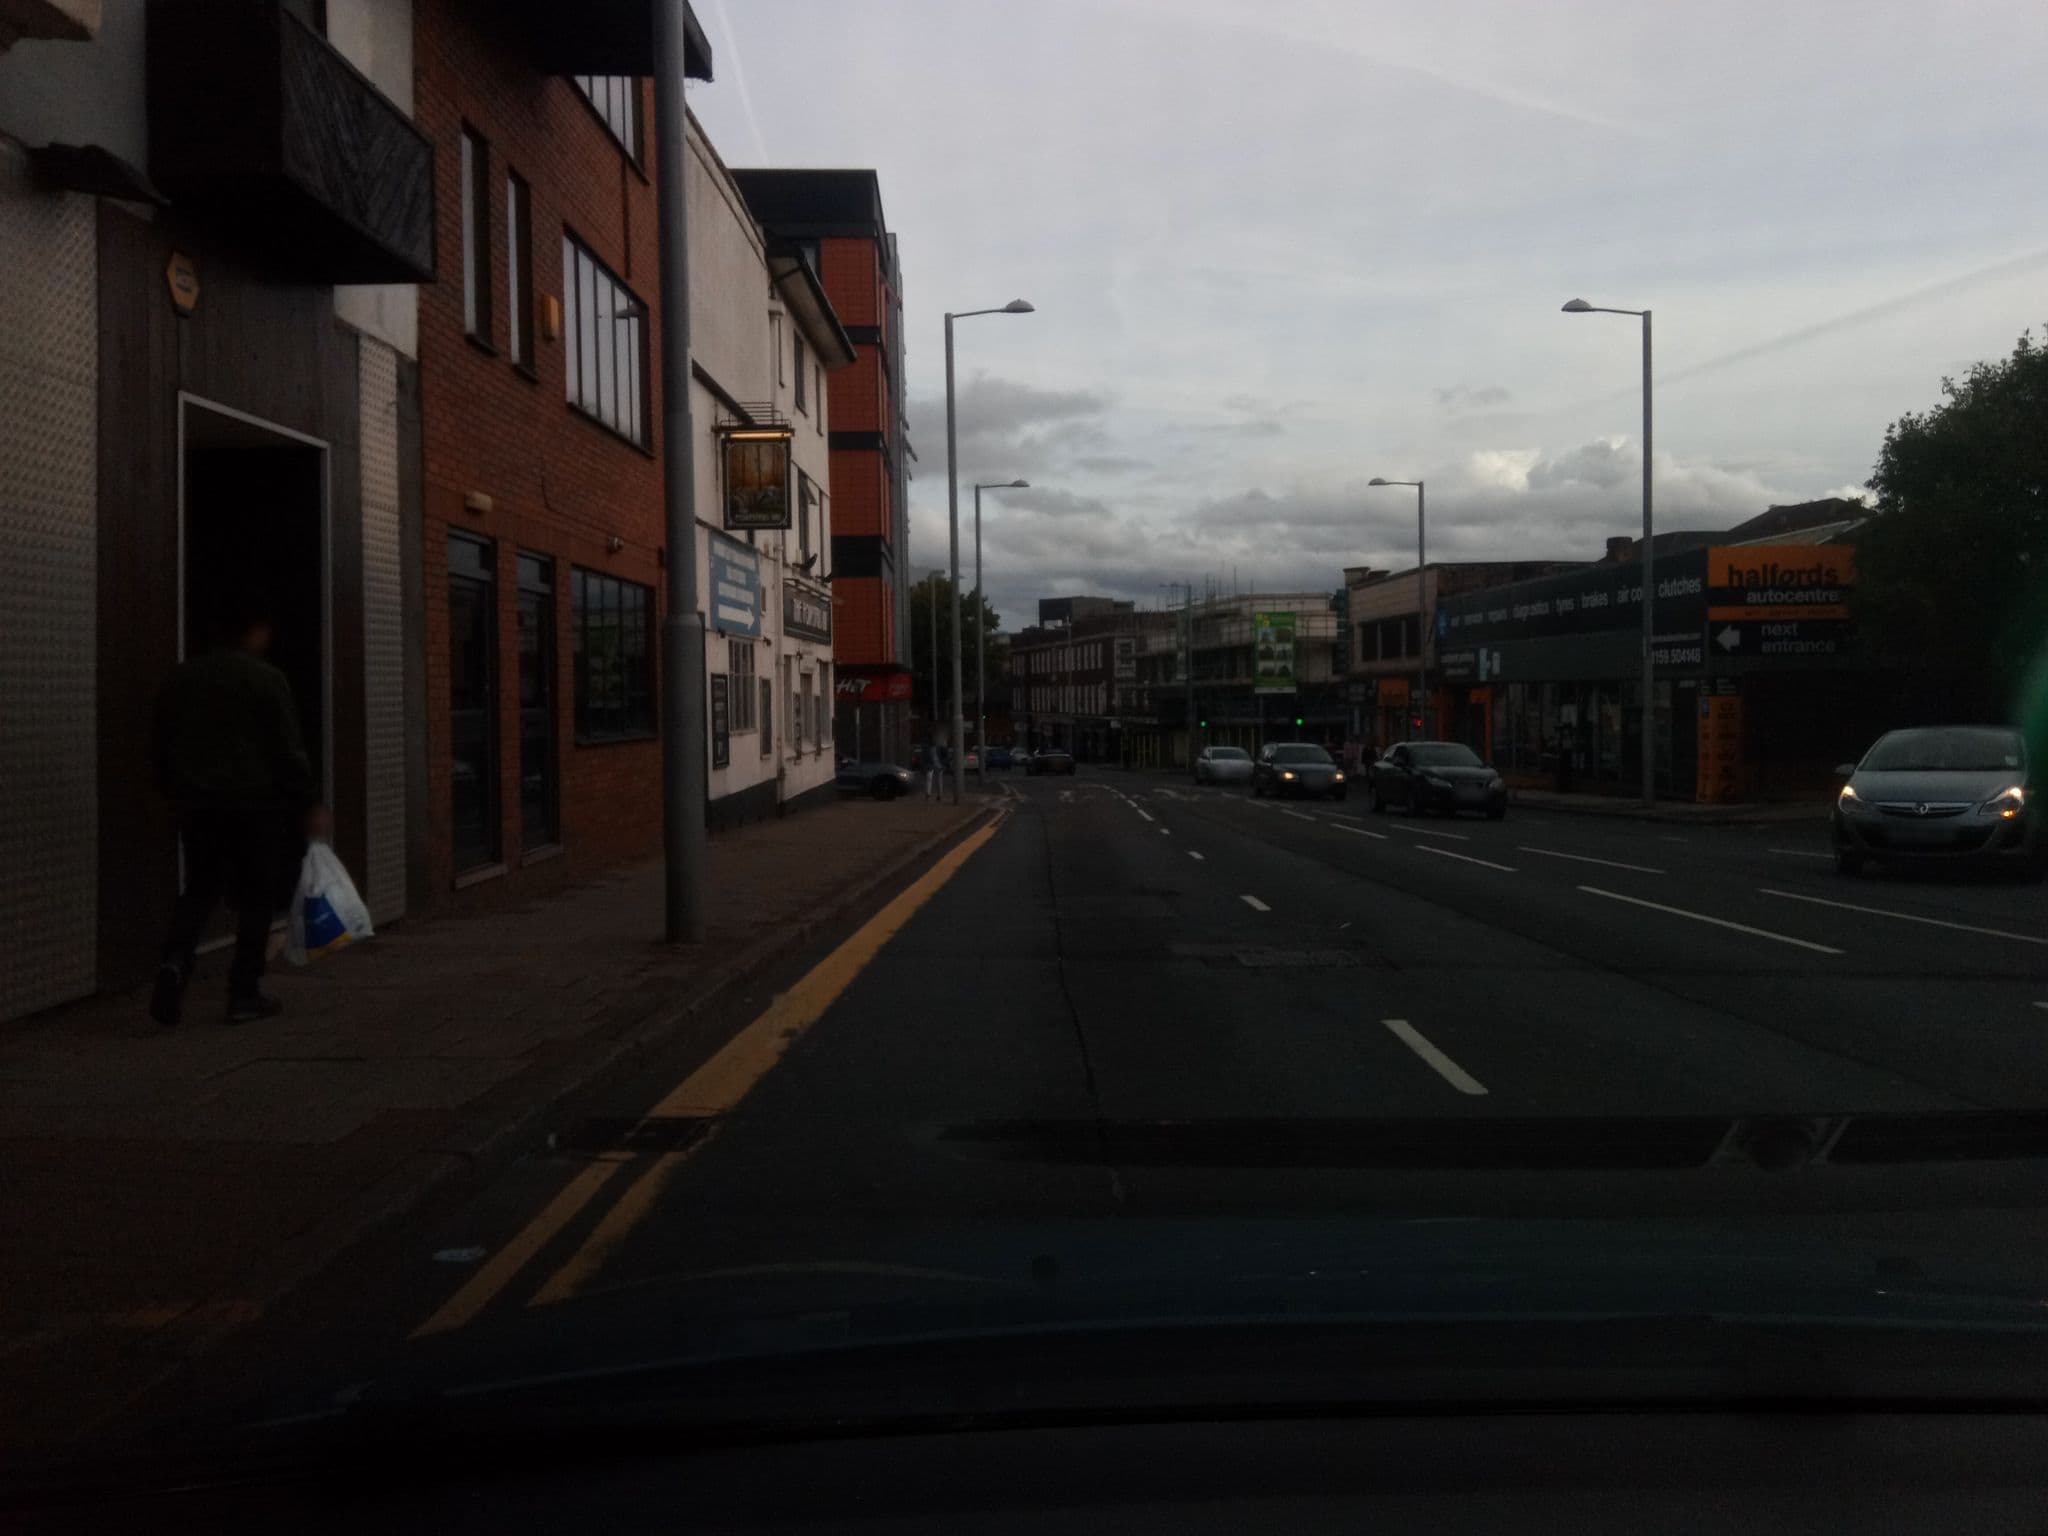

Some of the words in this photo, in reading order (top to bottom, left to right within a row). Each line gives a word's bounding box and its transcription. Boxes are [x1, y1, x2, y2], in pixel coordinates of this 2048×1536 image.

[1728, 562, 1839, 588] halfords
[1581, 592, 1608, 608] brakes
[1617, 586, 1630, 604] air
[1658, 577, 1701, 598] clutches
[1746, 588, 1840, 604] autocentre
[1760, 622, 1799, 637] next
[1761, 640, 1836, 654] entrance
